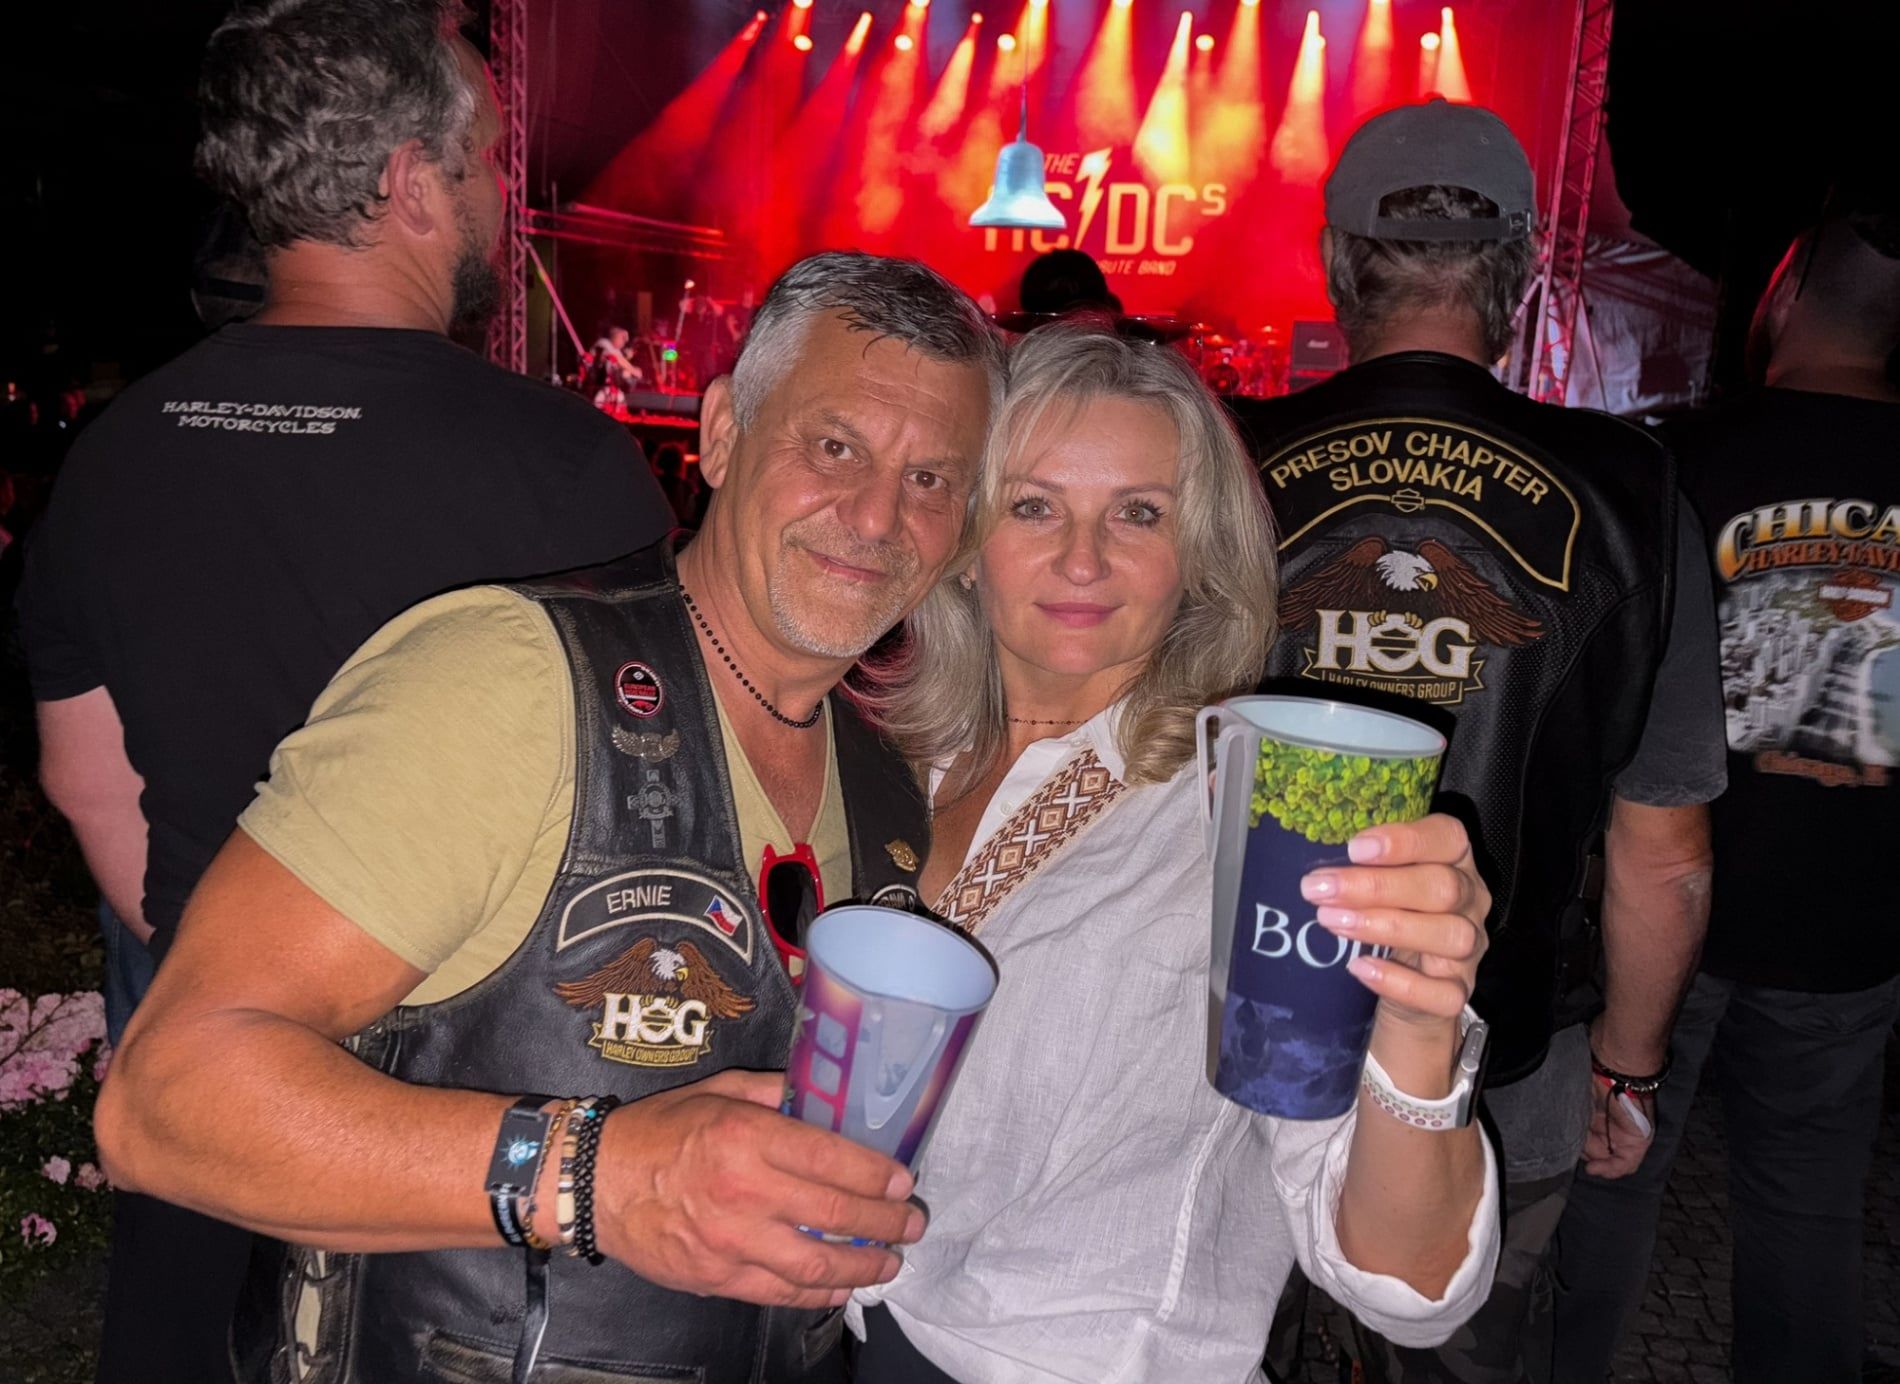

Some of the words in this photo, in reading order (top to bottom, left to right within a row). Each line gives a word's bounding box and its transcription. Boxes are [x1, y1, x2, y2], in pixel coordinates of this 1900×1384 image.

[1043, 152, 1080, 175] THE
[1096, 259, 1135, 275] BUTE
[161, 401, 363, 420] HARLEY-DAVIDSON
[177, 415, 336, 434] MOTORCYCLES
[1269, 430, 1393, 489] PRESOV
[1404, 430, 1550, 505] CHAPTER
[1328, 457, 1484, 501] SLOVAKIA
[1315, 608, 1477, 679] HOG
[1417, 681, 1458, 699] GROUP
[606, 885, 673, 914] ERNIE
[599, 992, 711, 1046] HOG
[606, 1040, 636, 1059] HARLEY
[635, 1047, 669, 1063] OWNERS
